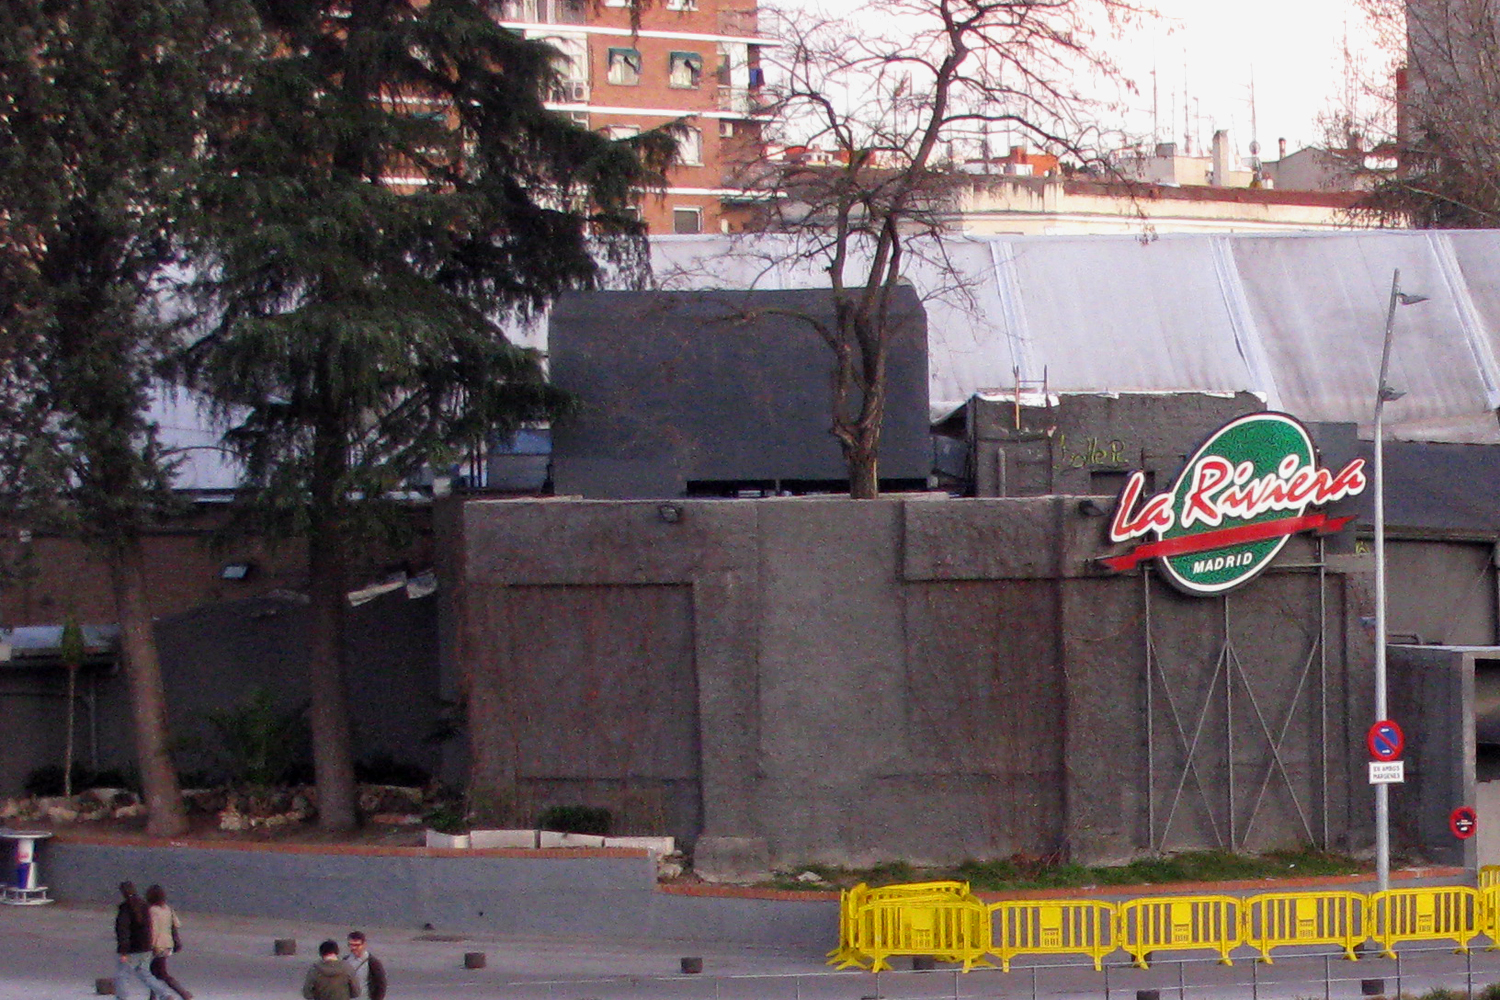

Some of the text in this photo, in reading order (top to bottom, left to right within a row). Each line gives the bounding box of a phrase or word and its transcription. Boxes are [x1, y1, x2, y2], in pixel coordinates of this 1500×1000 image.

[1111, 454, 1366, 542] La Riviera
[1192, 552, 1254, 575] MADRID
